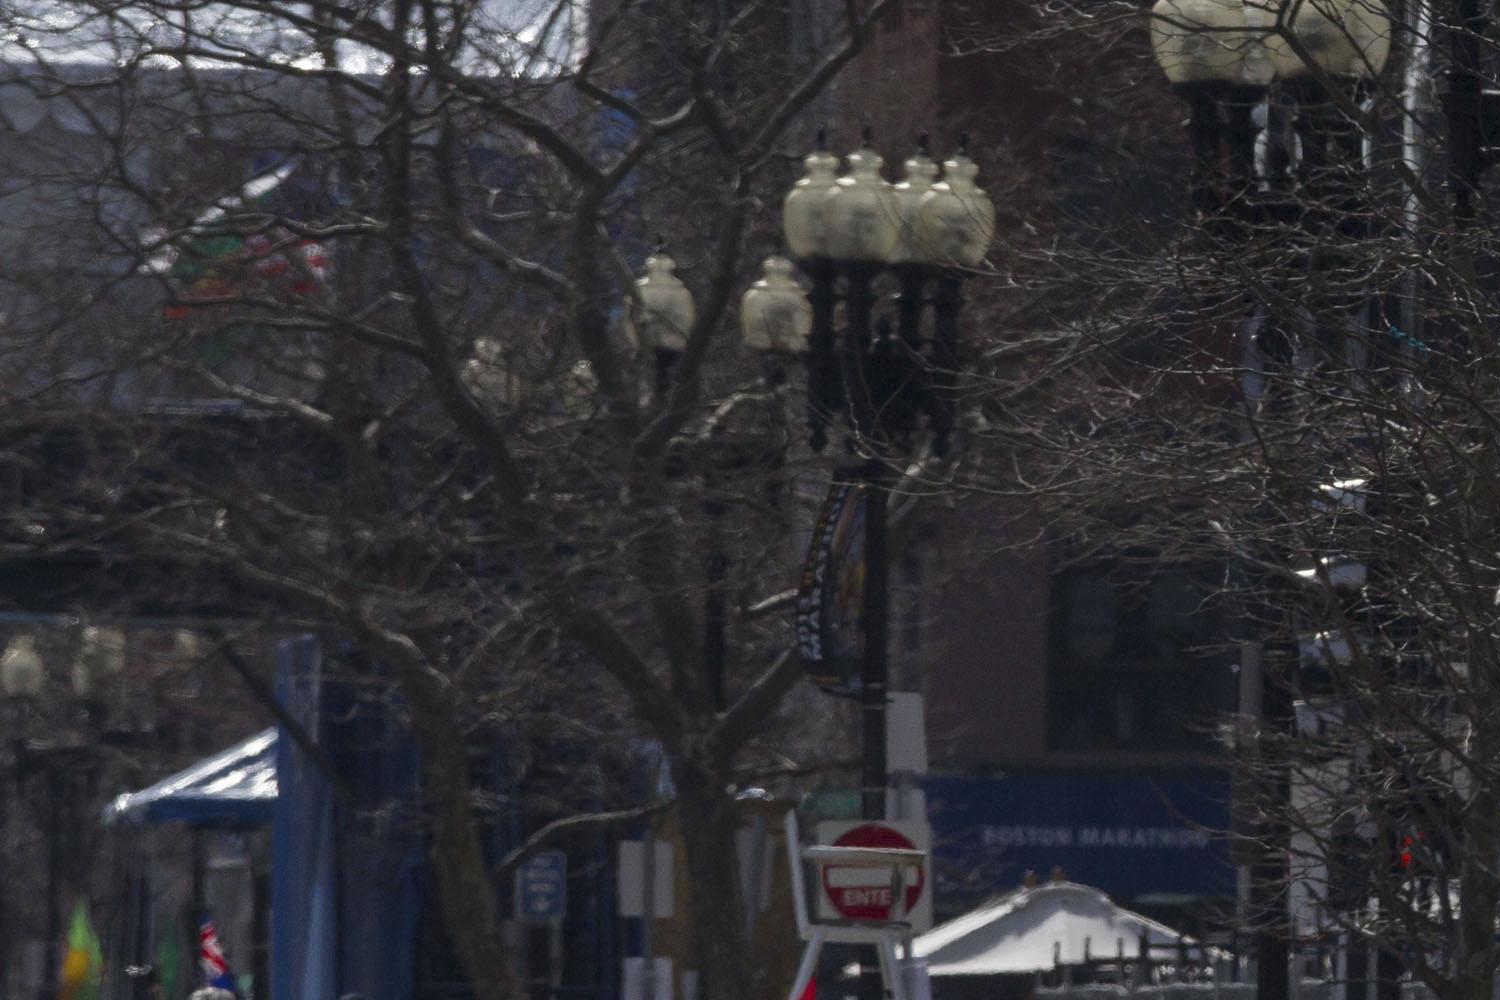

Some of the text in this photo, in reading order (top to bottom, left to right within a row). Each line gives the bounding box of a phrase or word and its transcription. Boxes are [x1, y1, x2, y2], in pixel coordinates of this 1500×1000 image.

[983, 825, 1209, 848] BOSTON MARATHON
[843, 888, 892, 907] ENTE
